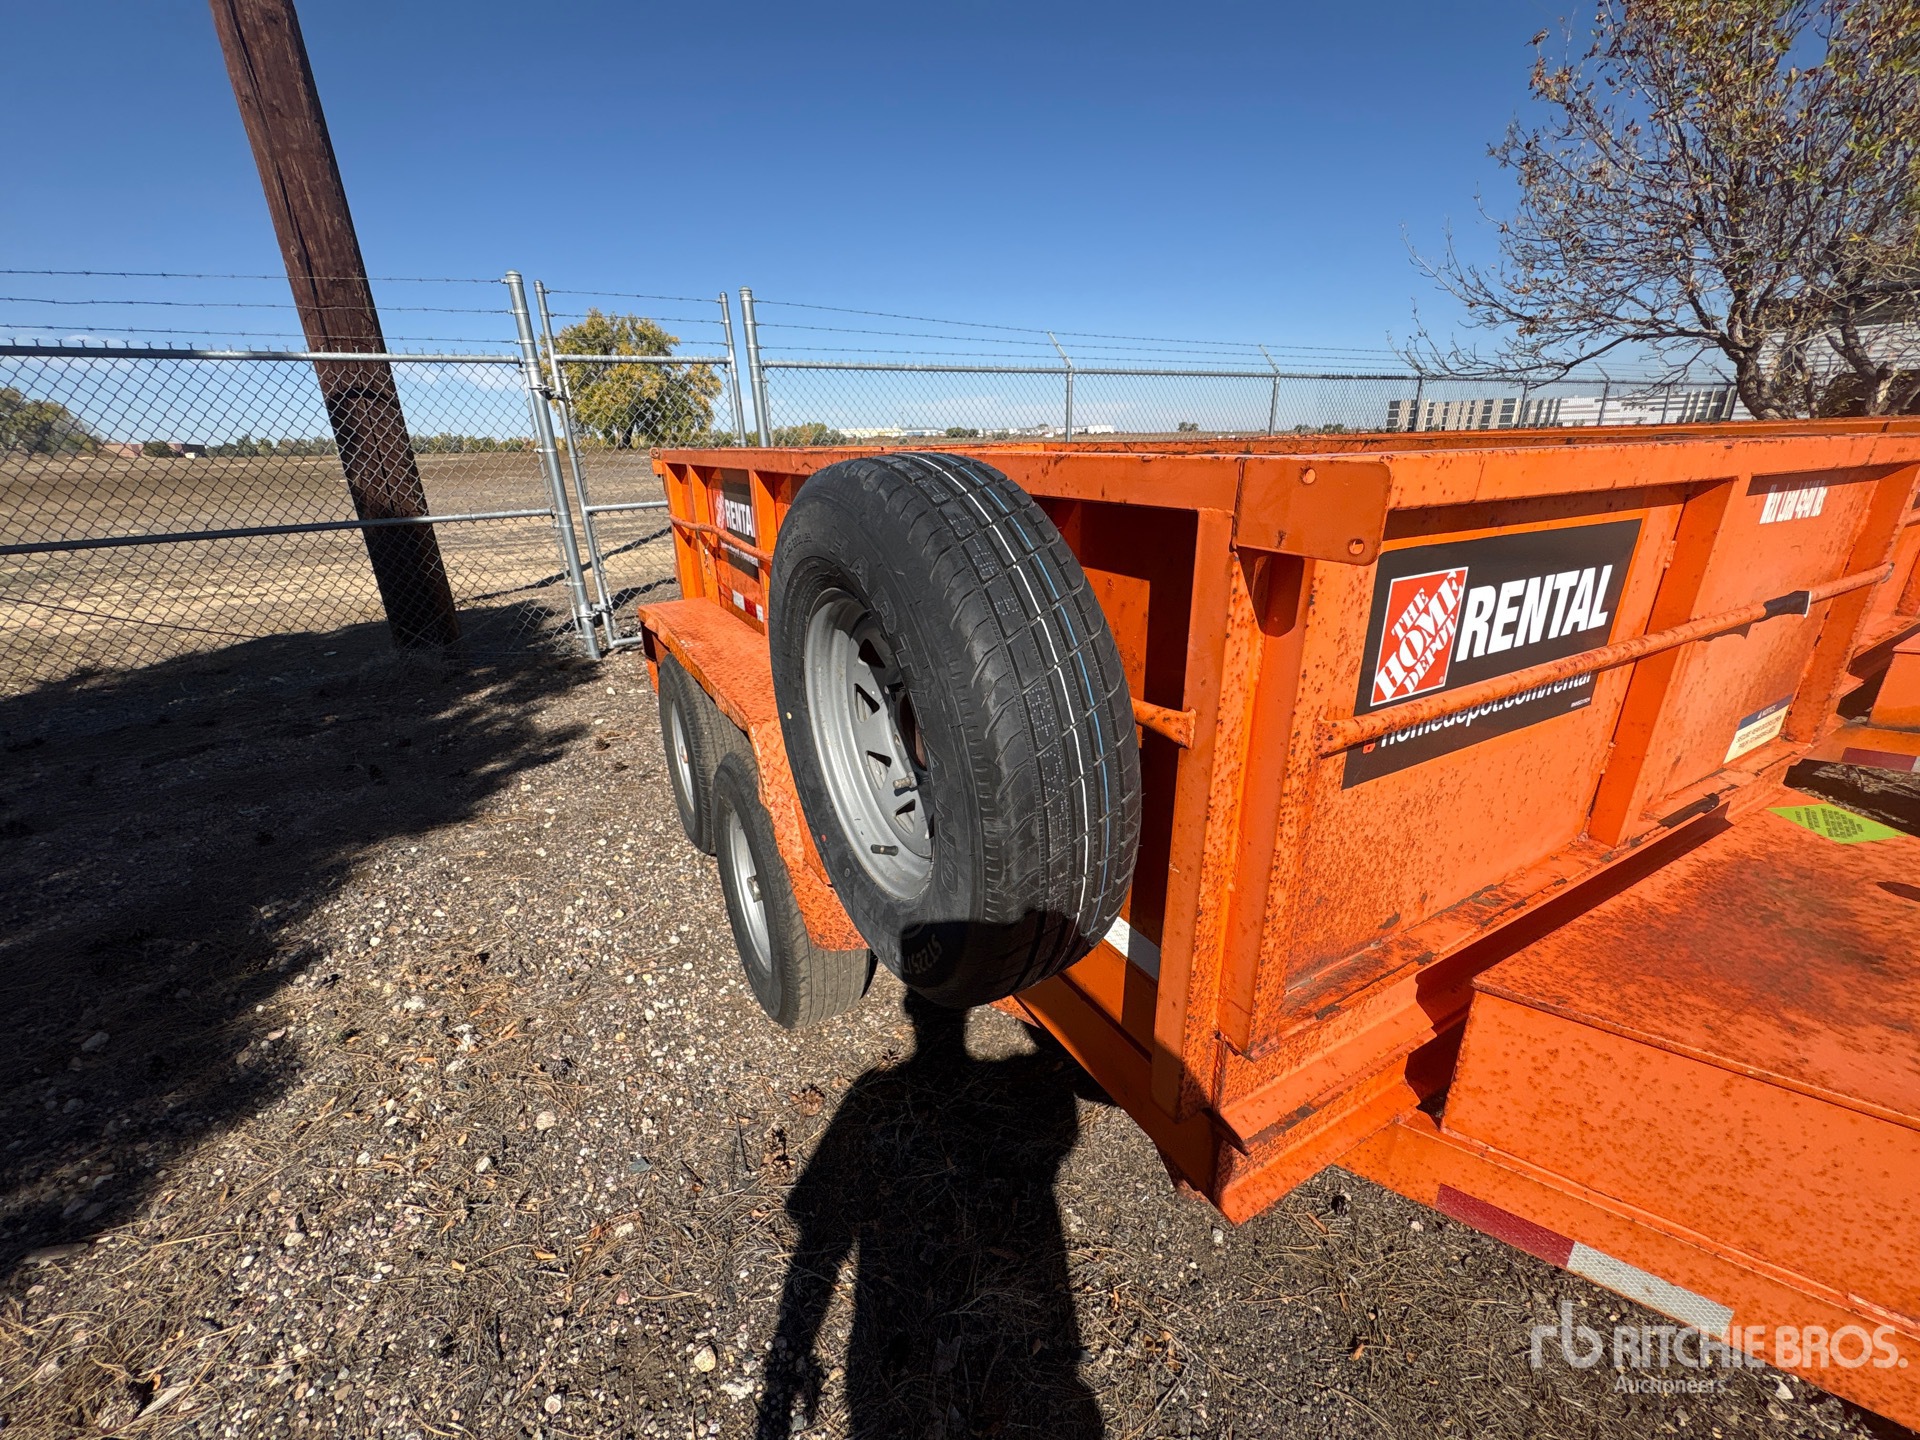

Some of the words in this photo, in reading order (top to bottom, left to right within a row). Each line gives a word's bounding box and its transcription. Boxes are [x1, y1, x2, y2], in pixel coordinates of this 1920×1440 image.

[1375, 570, 1464, 700] HOME
[1390, 587, 1429, 641] THE
[1402, 614, 1456, 694] DEPOT
[1455, 564, 1613, 663] RENTAL
